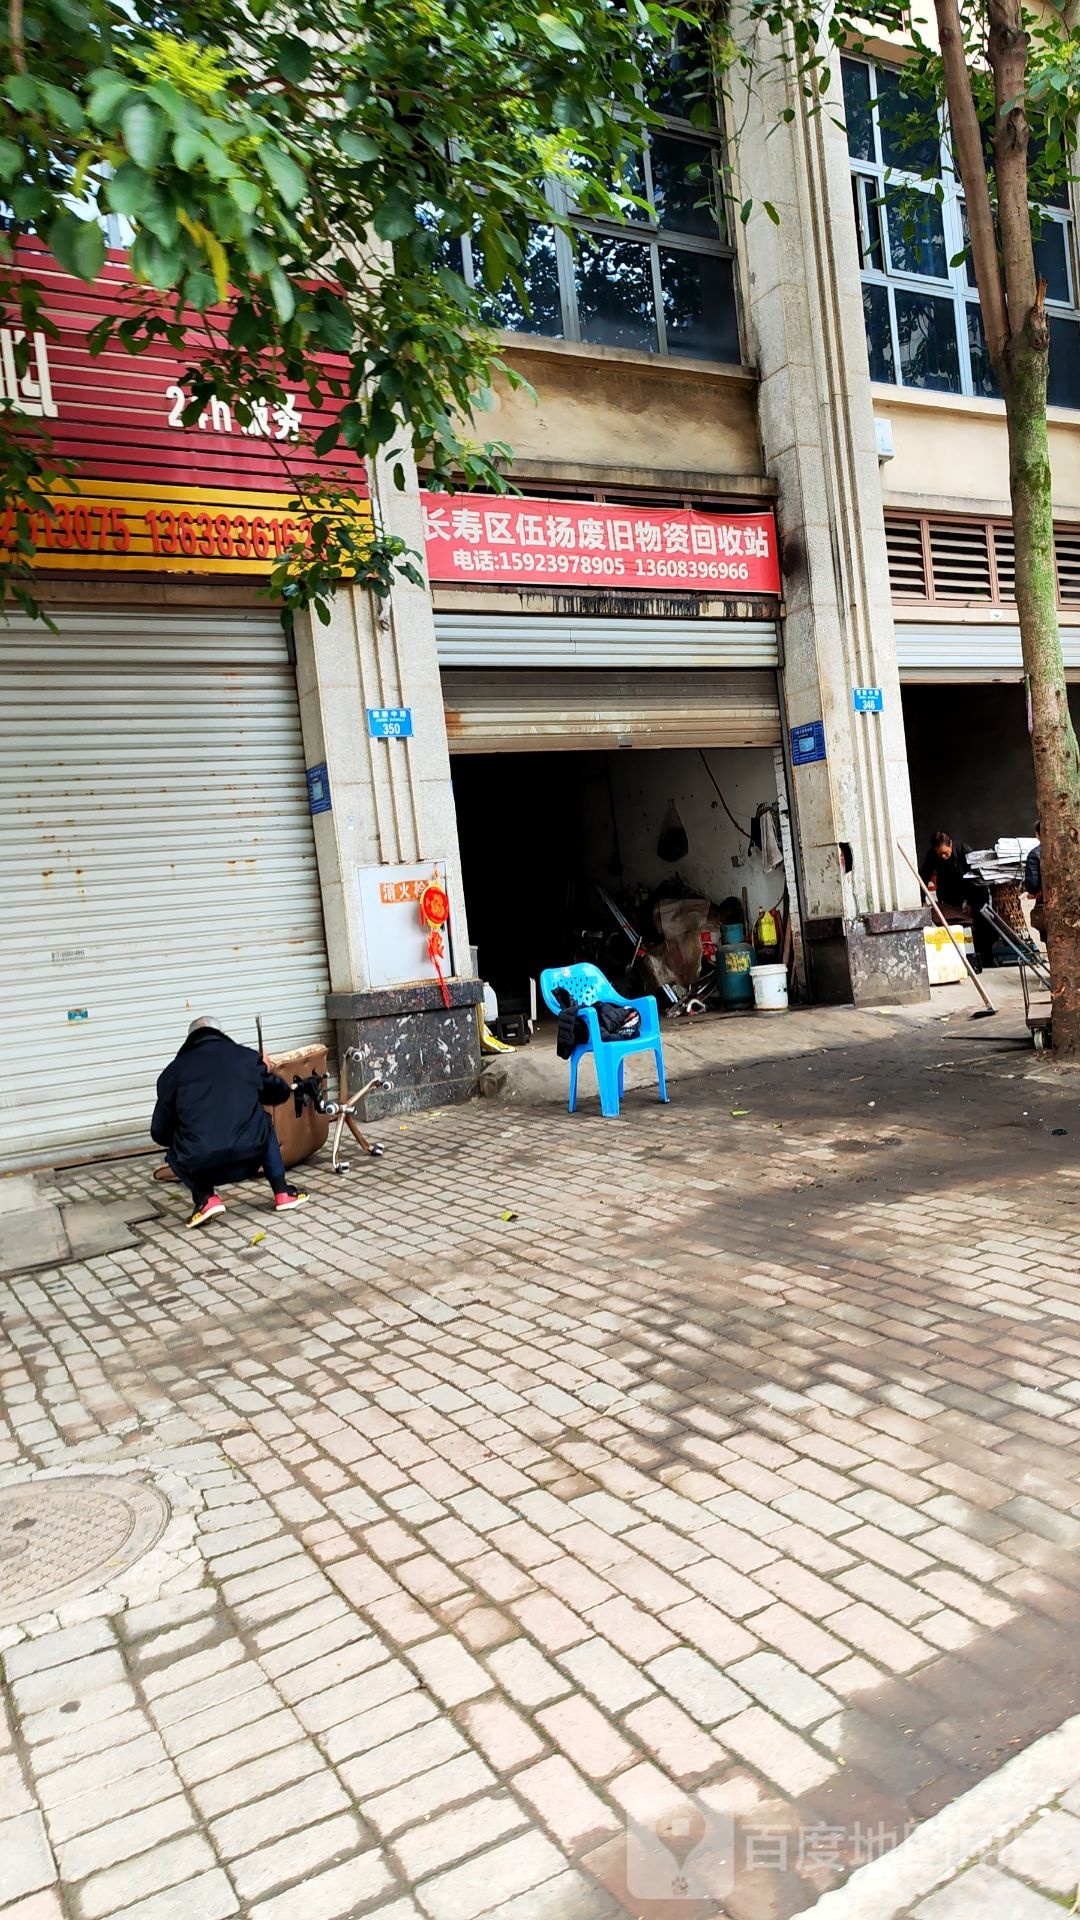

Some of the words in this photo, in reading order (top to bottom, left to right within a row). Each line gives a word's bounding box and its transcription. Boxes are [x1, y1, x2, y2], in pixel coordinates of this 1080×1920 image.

[421, 506, 769, 558] 长寿区伍扬废旧物资回收站
[453, 548, 625, 575] 电话:15923978905
[635, 558, 749, 580] 13608396966
[862, 699, 876, 710] 348
[382, 723, 401, 735] 350
